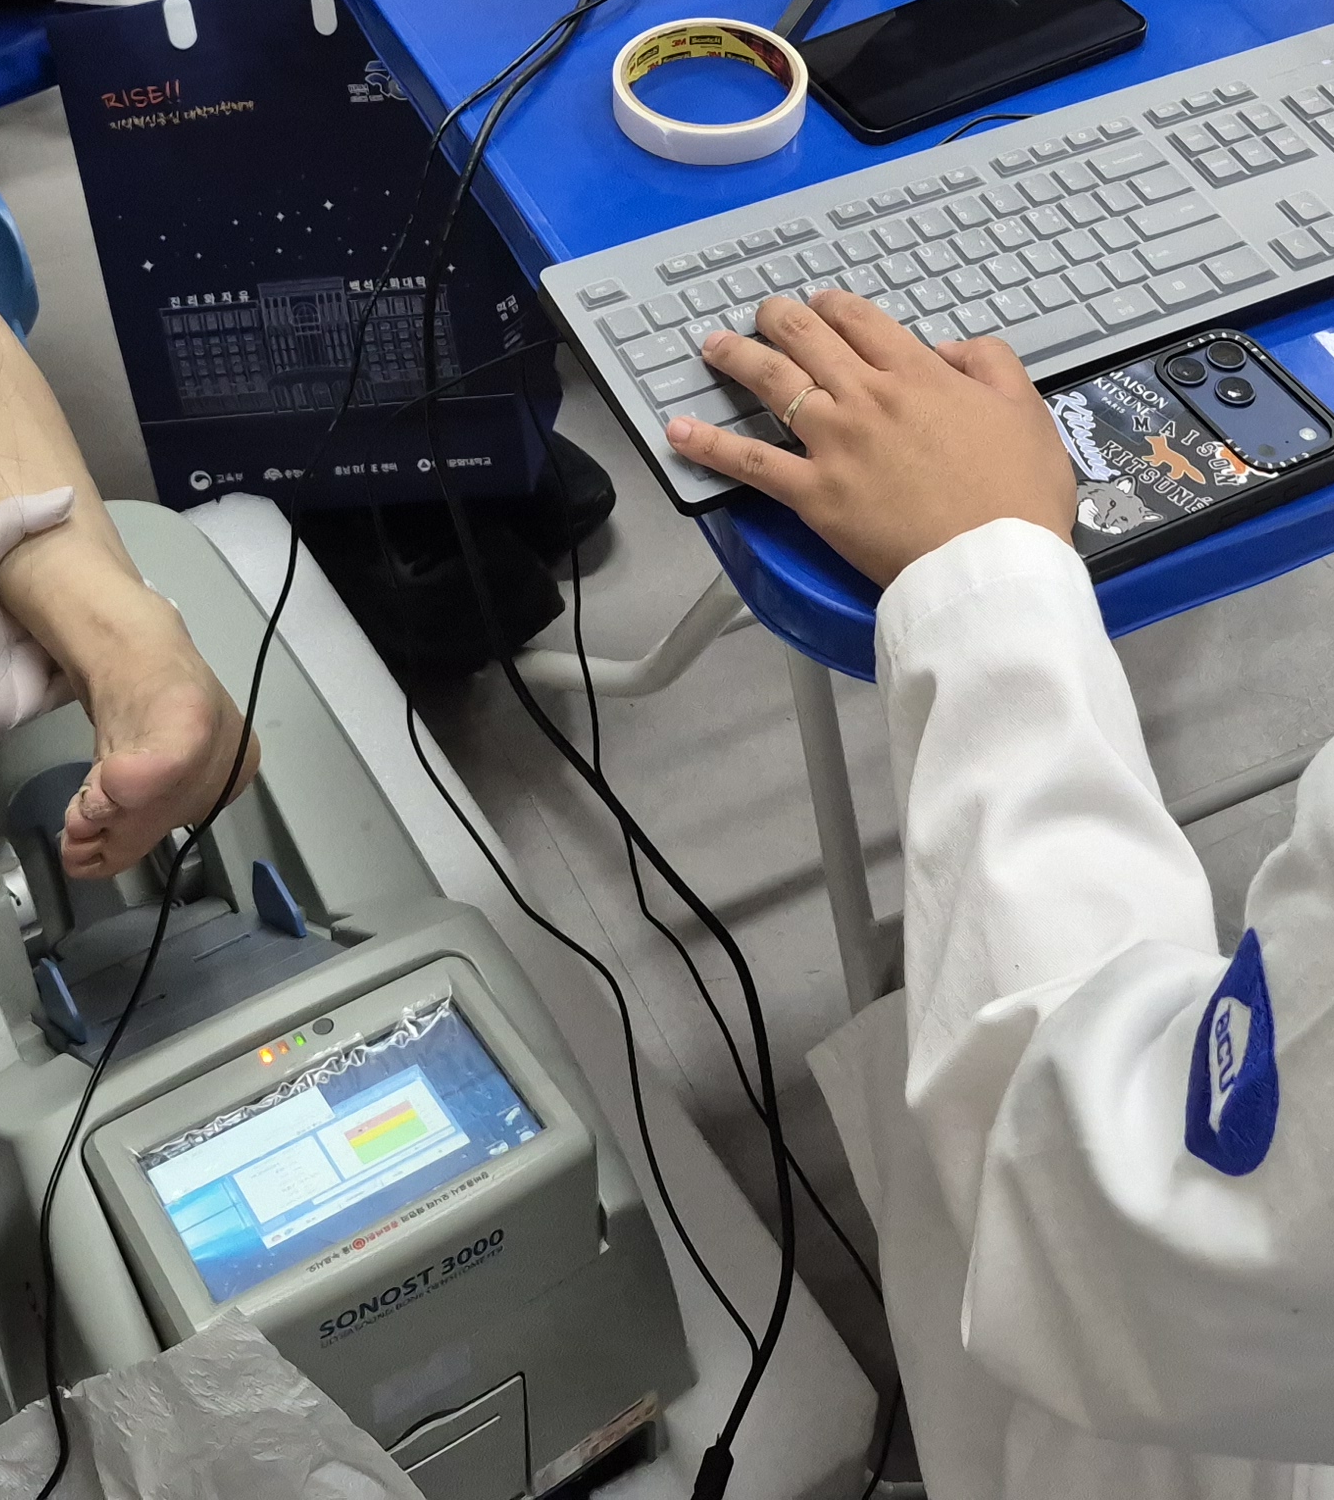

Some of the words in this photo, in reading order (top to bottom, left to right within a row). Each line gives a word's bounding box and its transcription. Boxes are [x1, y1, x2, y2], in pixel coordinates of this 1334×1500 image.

[101, 79, 181, 109] RISE!!
[728, 307, 745, 323] W
[689, 322, 704, 334] Q
[1101, 396, 1126, 414] PARIS
[319, 1266, 435, 1340] SONOST
[441, 1228, 504, 1276] 3000
